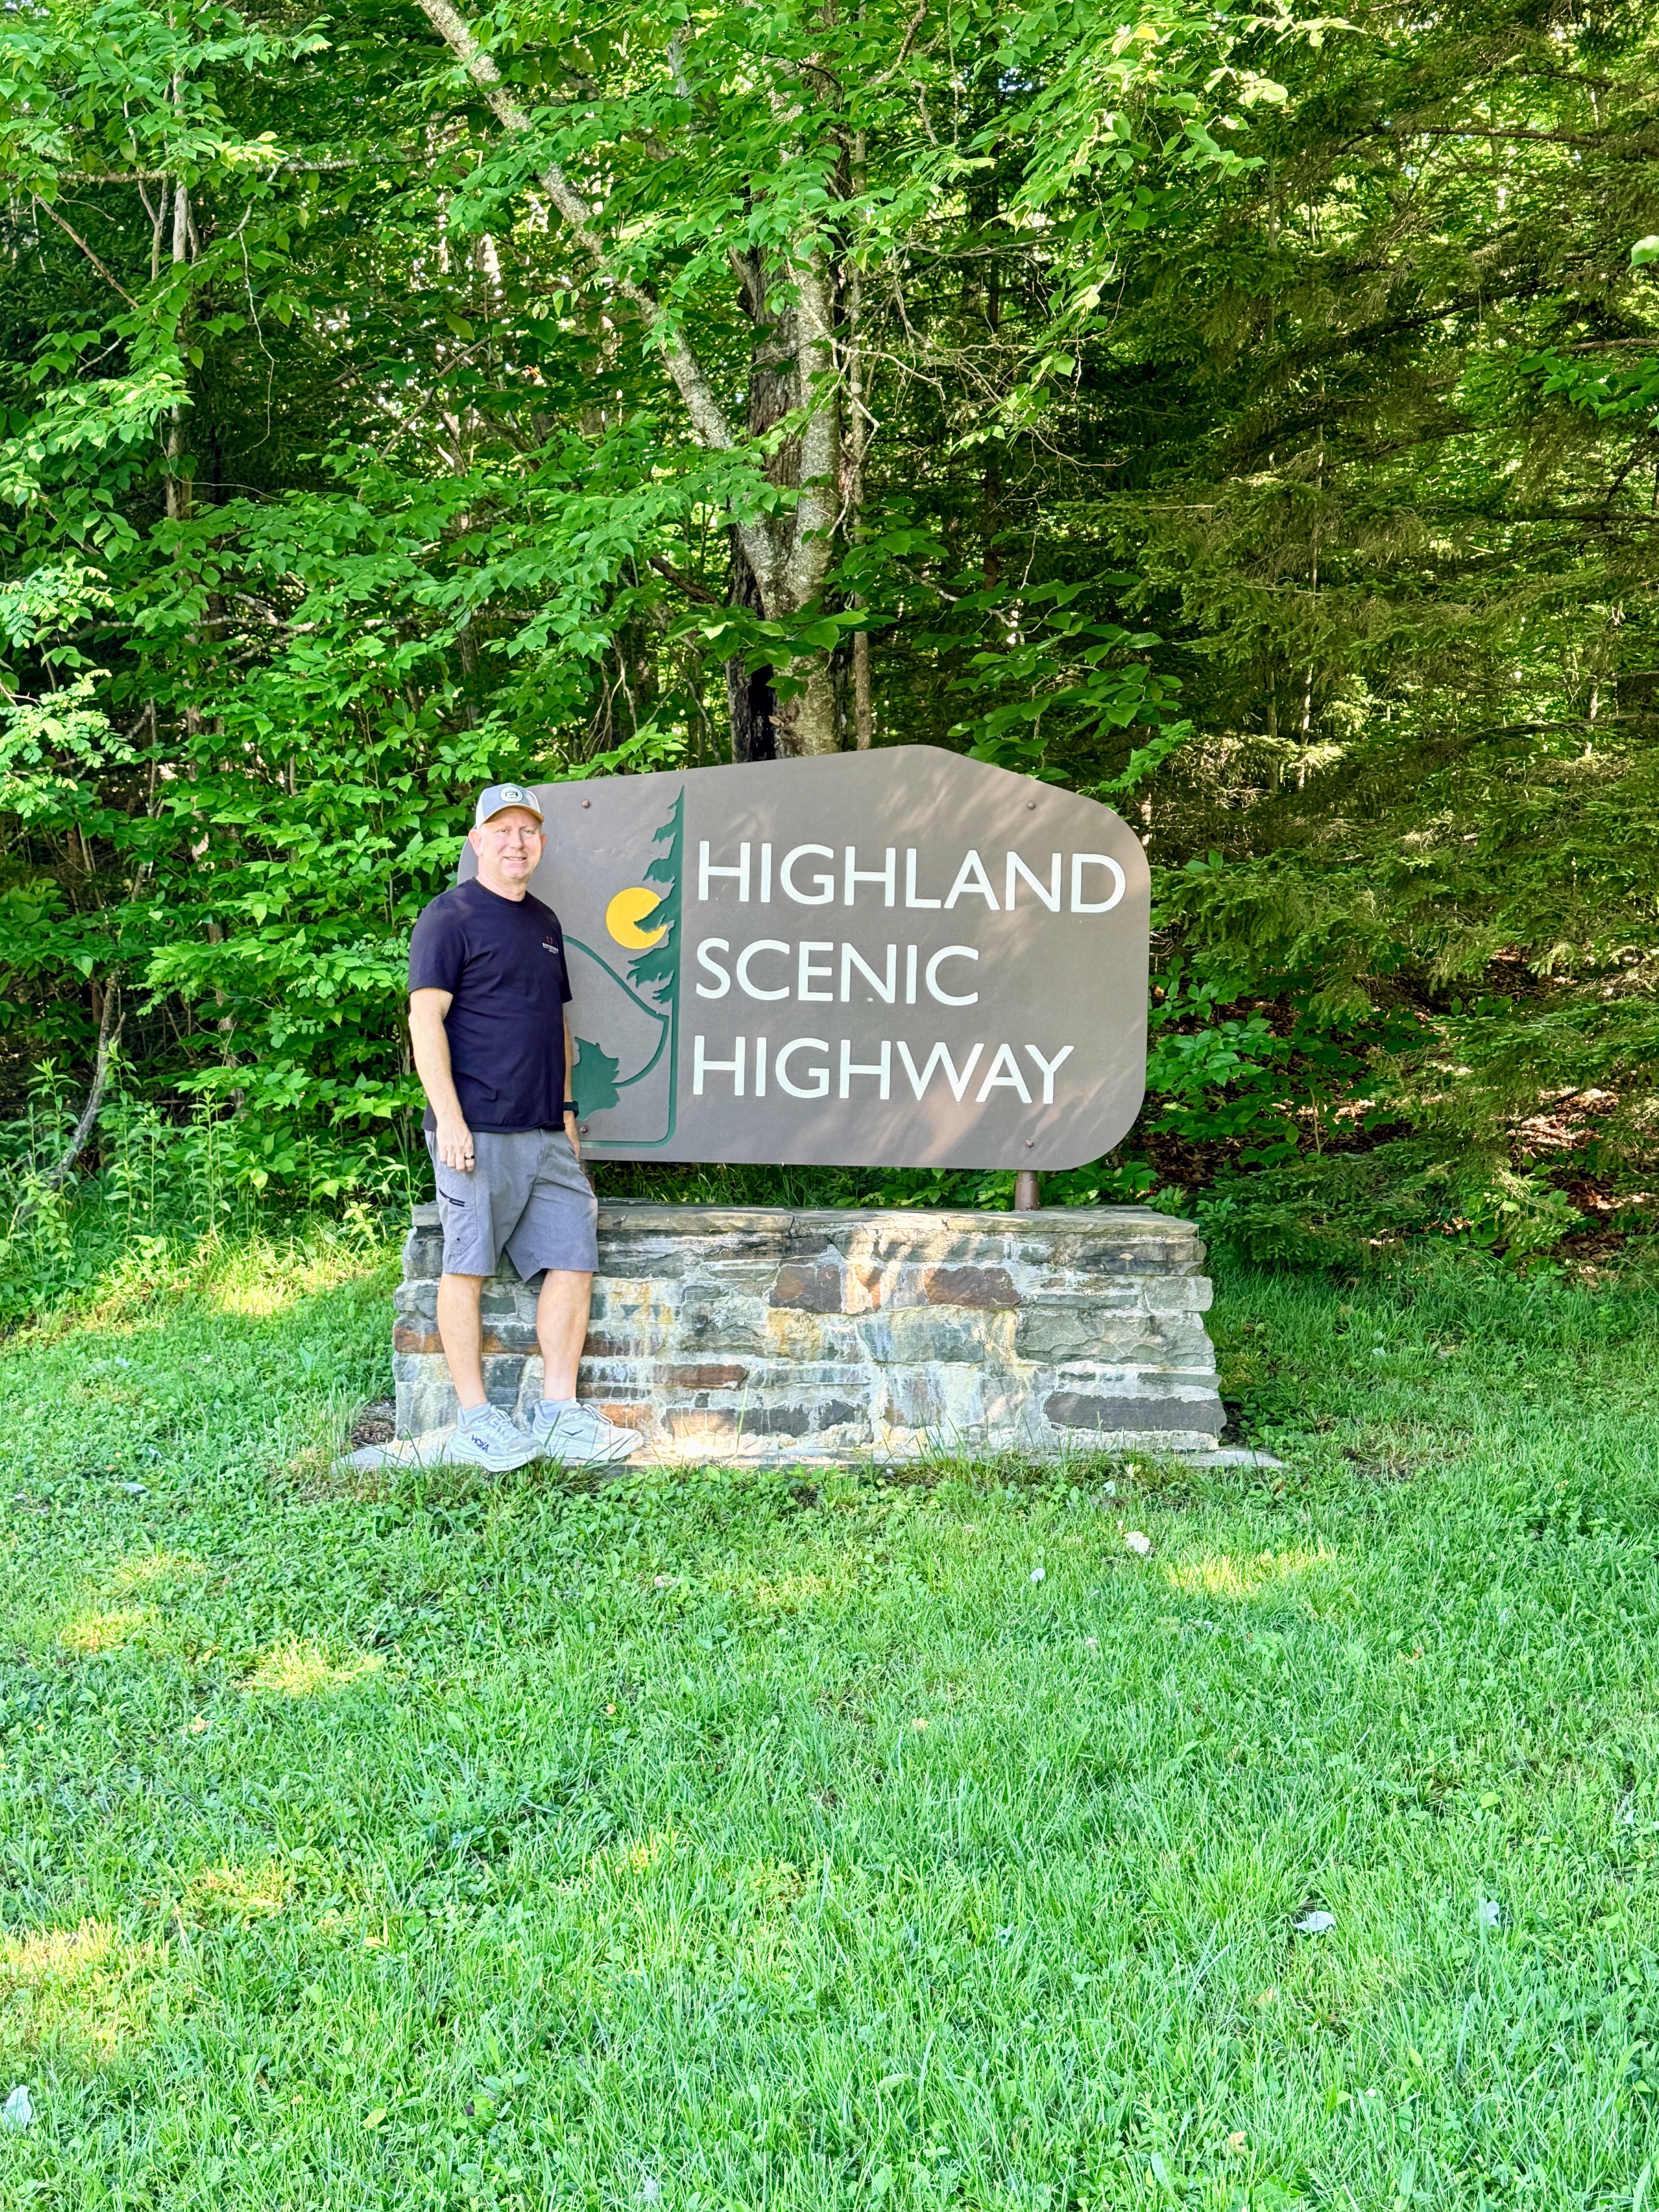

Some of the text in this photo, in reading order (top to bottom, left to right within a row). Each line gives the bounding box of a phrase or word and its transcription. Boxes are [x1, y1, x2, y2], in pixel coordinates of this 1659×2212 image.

[698, 840, 1126, 913] HIGHLAND
[696, 938, 979, 1006] SCENIC
[692, 1036, 1074, 1104] HIGHWAY
